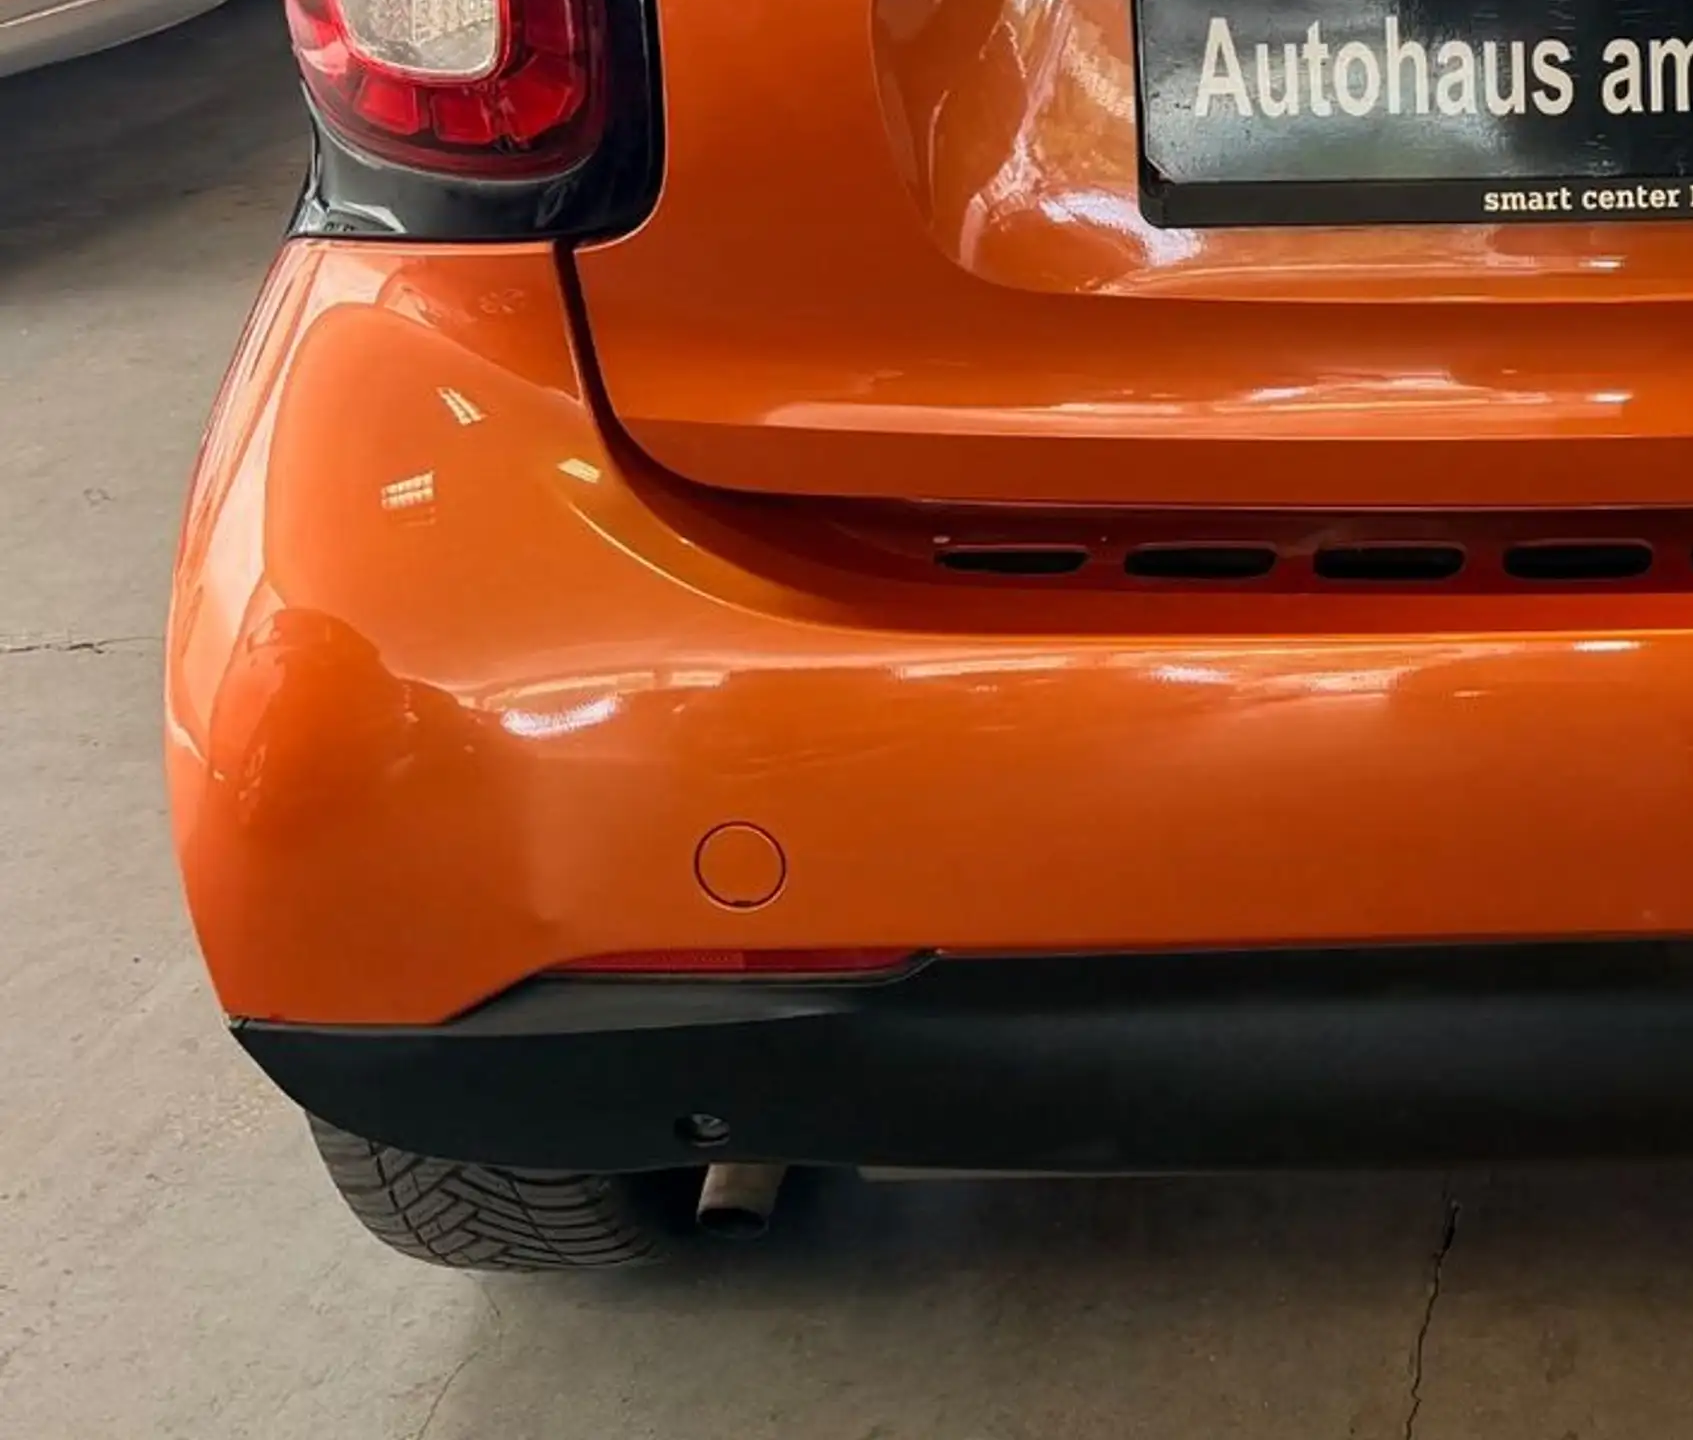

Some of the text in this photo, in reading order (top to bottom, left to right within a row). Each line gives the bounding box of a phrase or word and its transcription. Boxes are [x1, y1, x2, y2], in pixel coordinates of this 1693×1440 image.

[1195, 15, 1574, 117] Autohaus
[1484, 186, 1572, 211] smart
[1581, 183, 1681, 210] center
